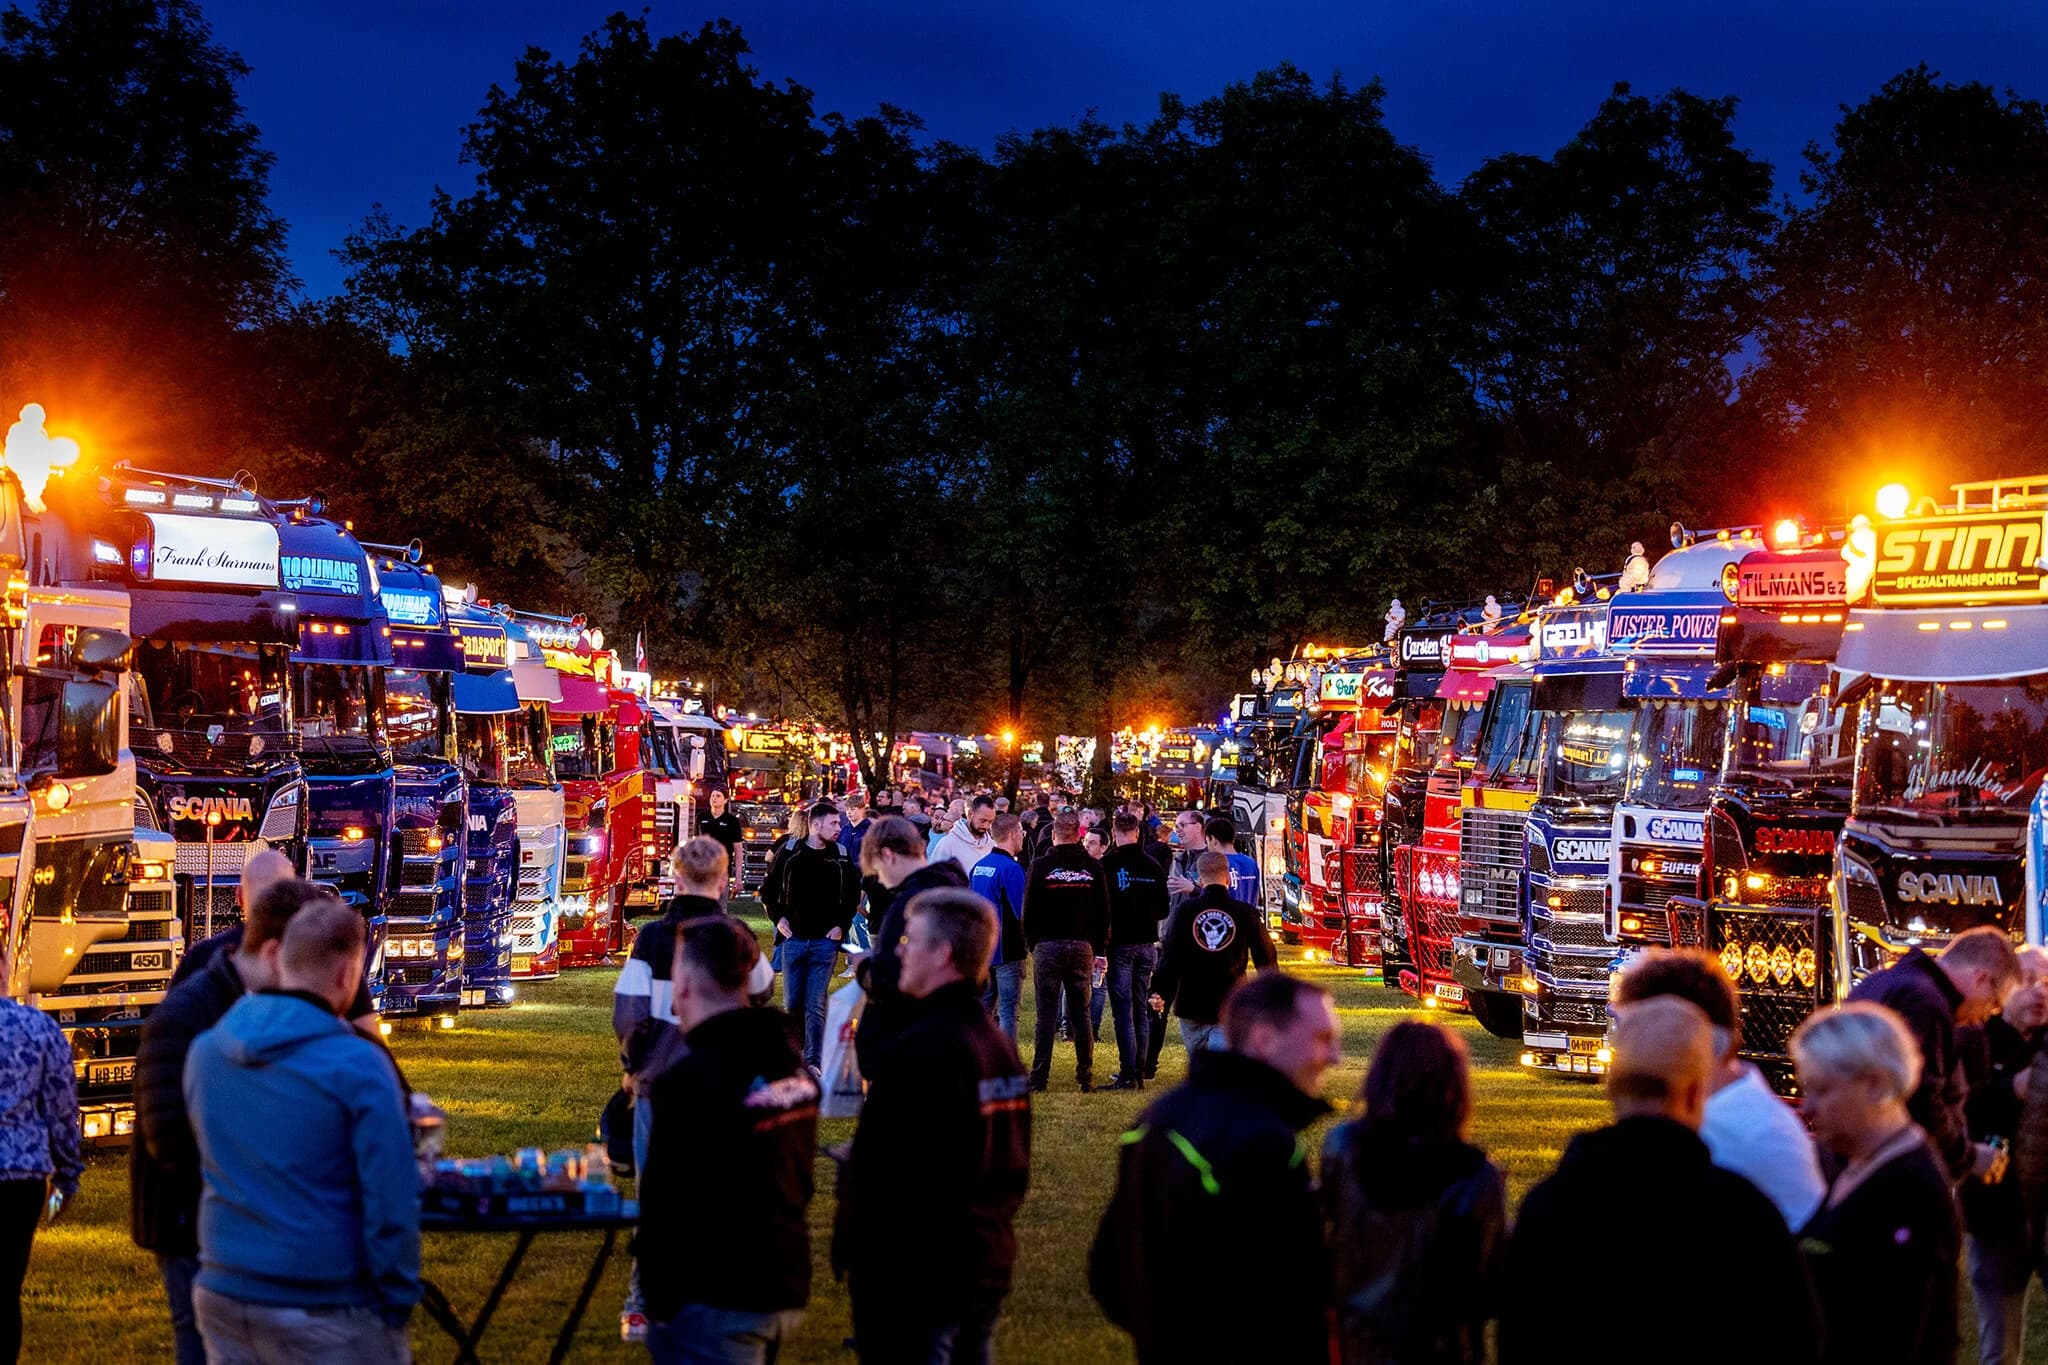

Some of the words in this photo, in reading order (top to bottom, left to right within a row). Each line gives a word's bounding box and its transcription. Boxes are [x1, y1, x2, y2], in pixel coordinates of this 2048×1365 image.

[156, 546, 208, 566] Frank
[207, 550, 275, 571] Starmans
[1877, 523, 2041, 573] STINN
[1743, 571, 1825, 597] TILMANS
[1827, 581, 1837, 595] &
[1896, 572, 2018, 589] SPEZIALTRANSPORTE
[1611, 615, 1665, 639] MISTER
[1402, 636, 1439, 660] Carsten
[169, 796, 253, 821] SCANIA
[1651, 820, 1703, 841] SCANIA
[1755, 827, 1836, 856] SCANIA
[312, 853, 337, 869] AF
[1490, 867, 1519, 881] MA
[1897, 871, 2003, 906] SCANIA
[133, 954, 161, 967] 450
